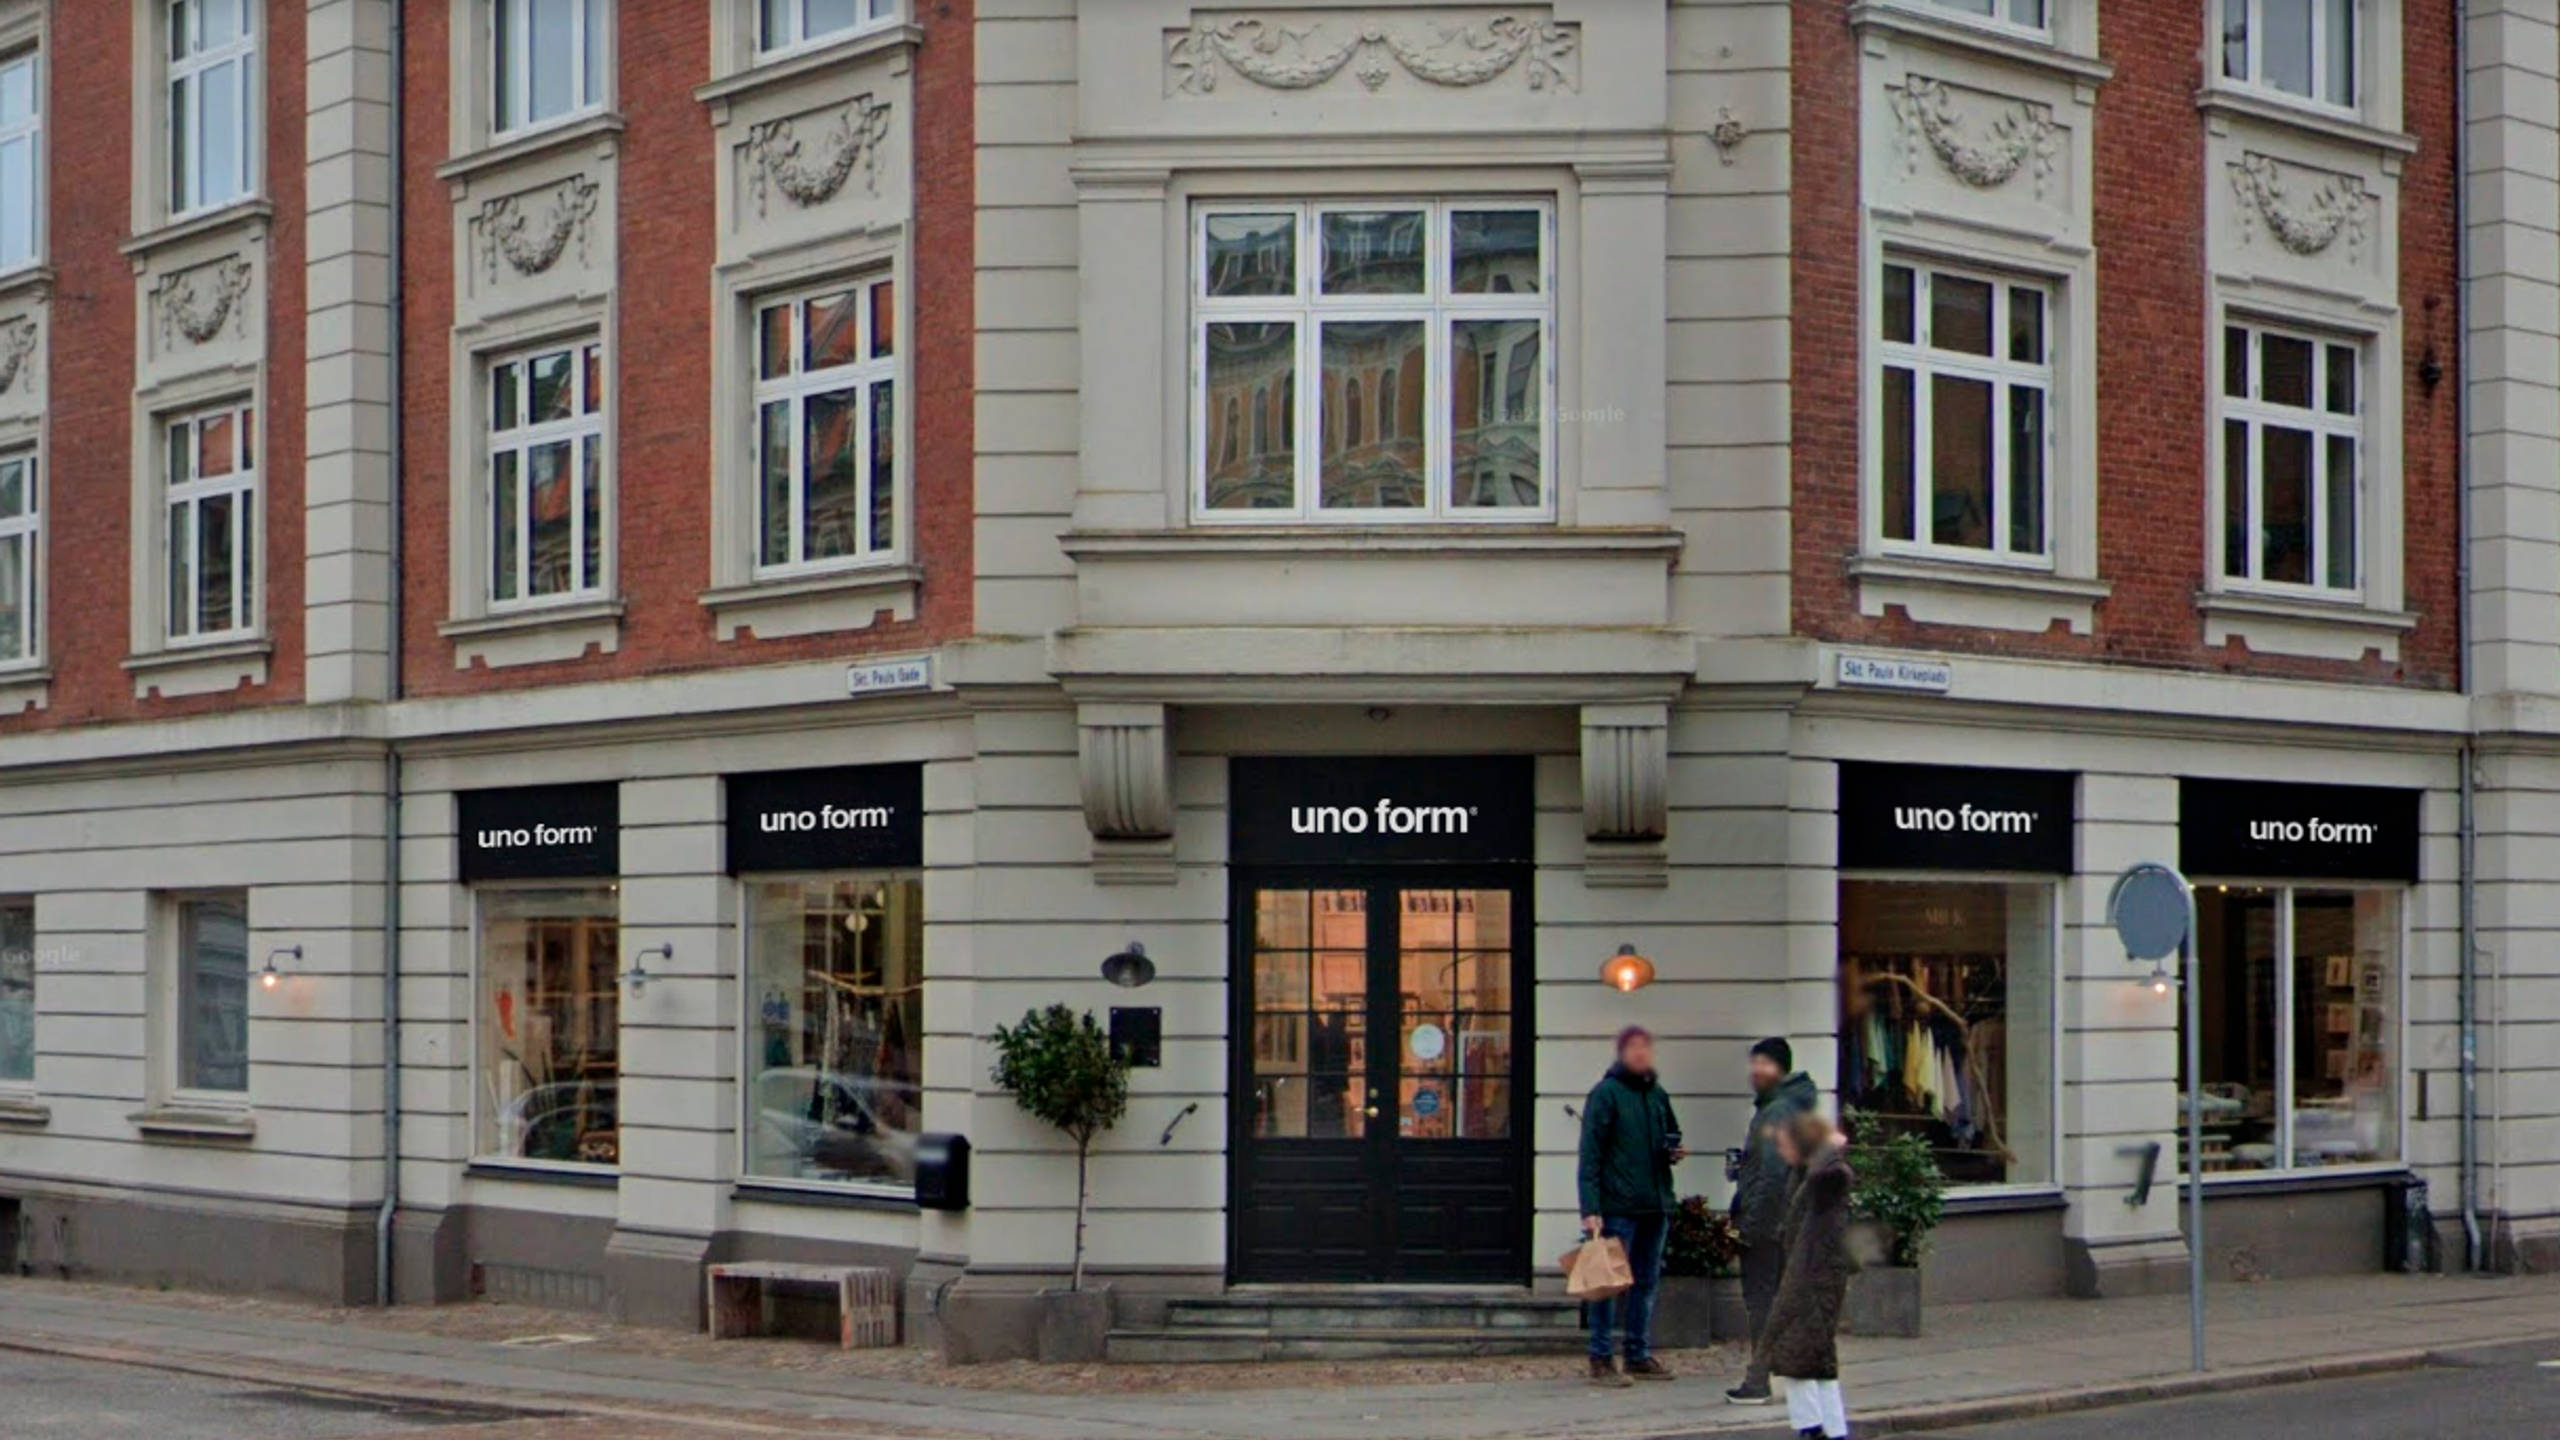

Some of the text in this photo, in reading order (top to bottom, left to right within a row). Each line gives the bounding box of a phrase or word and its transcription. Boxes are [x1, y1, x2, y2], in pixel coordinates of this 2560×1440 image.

[1868, 661, 1895, 679] Pauls
[760, 810, 817, 833] uno
[1291, 806, 1369, 834] uno
[1894, 807, 1955, 831] uno
[478, 828, 531, 849] uno
[2250, 820, 2304, 842] uno
